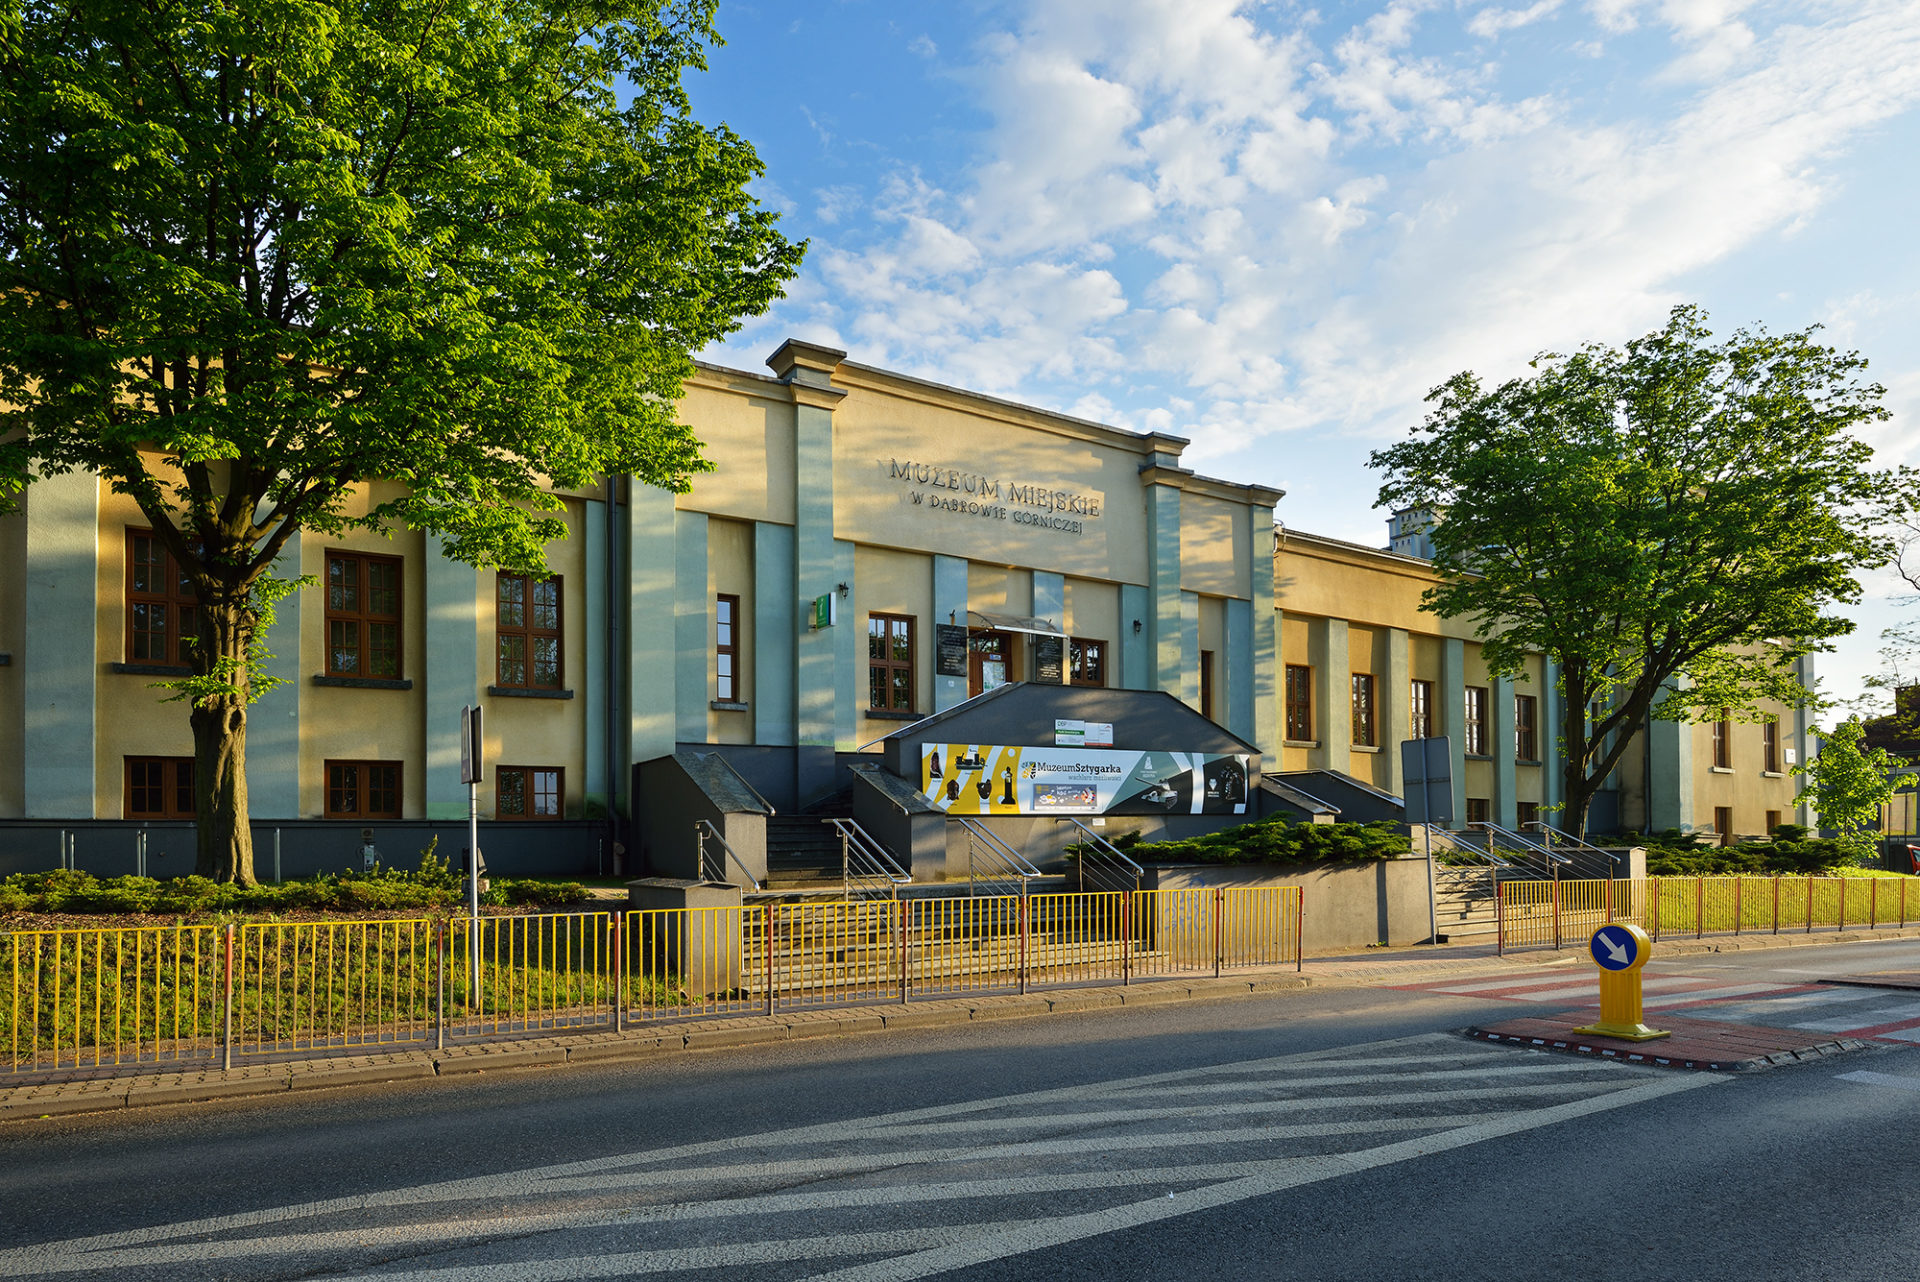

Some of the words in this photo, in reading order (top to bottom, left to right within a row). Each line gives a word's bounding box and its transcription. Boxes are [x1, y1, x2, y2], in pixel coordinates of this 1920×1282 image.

[890, 458, 1000, 499] MUZEUM
[1010, 482, 1100, 517] MIEJSKIE
[910, 490, 924, 504] W
